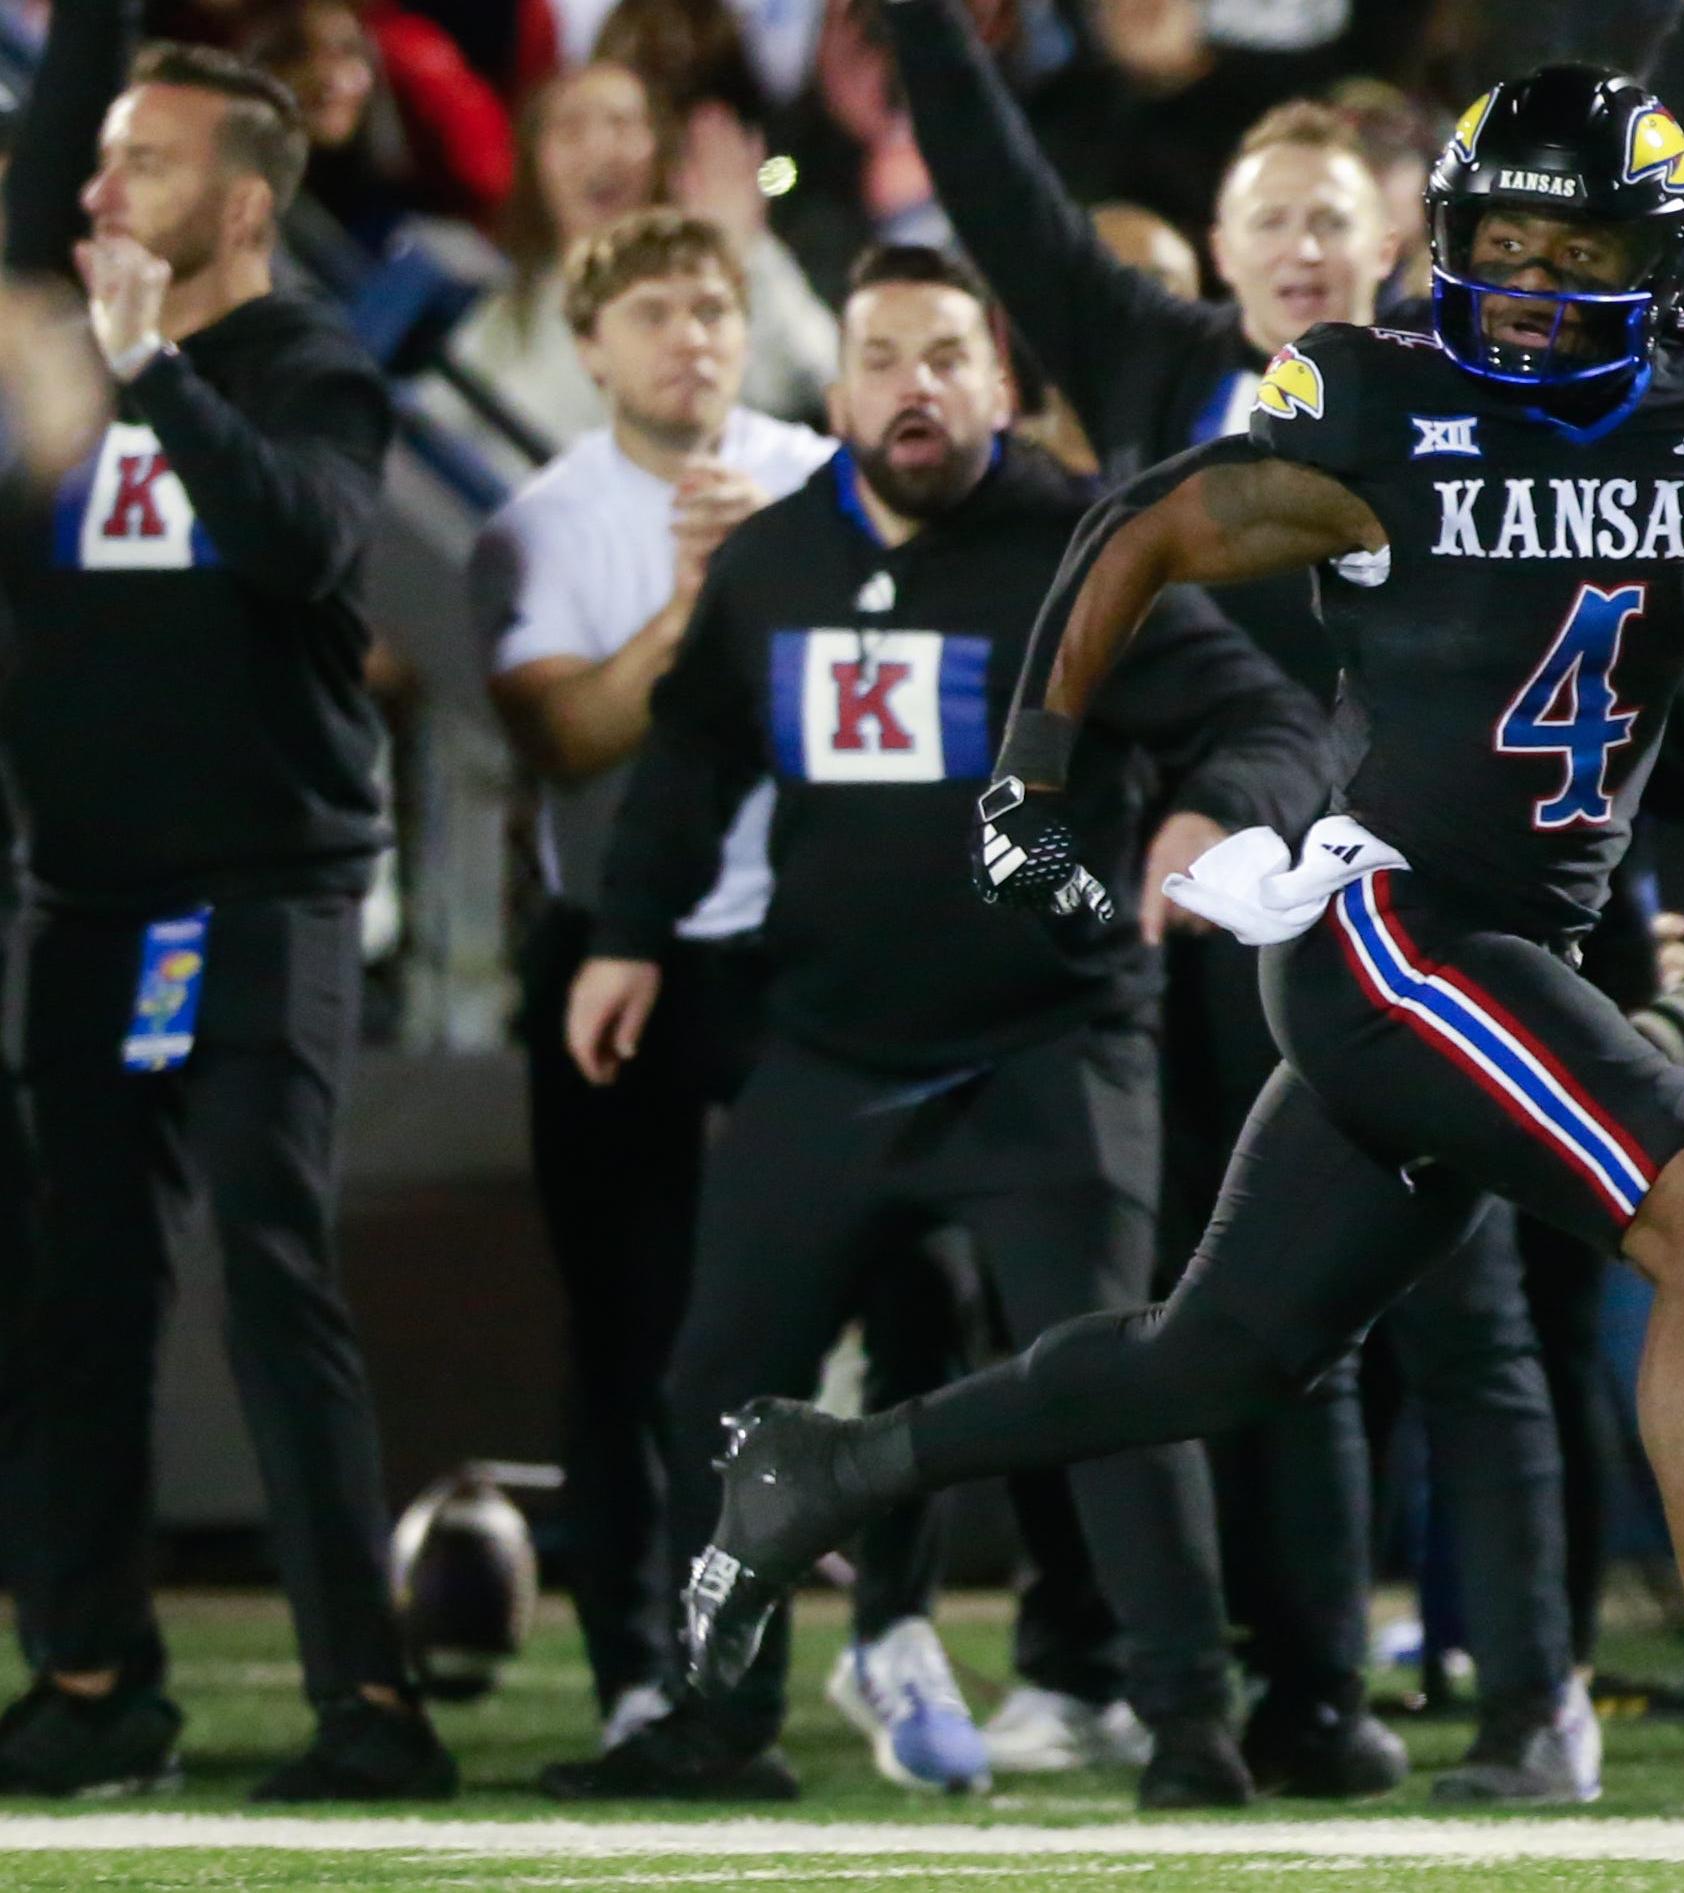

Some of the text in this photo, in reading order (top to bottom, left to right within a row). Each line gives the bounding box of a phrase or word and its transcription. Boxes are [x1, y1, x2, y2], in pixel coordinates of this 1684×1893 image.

[1499, 169, 1576, 197] KANSAS
[1411, 416, 1481, 455] XII
[102, 454, 169, 537] K
[831, 661, 915, 750] K
[1495, 583, 1646, 830] 4
